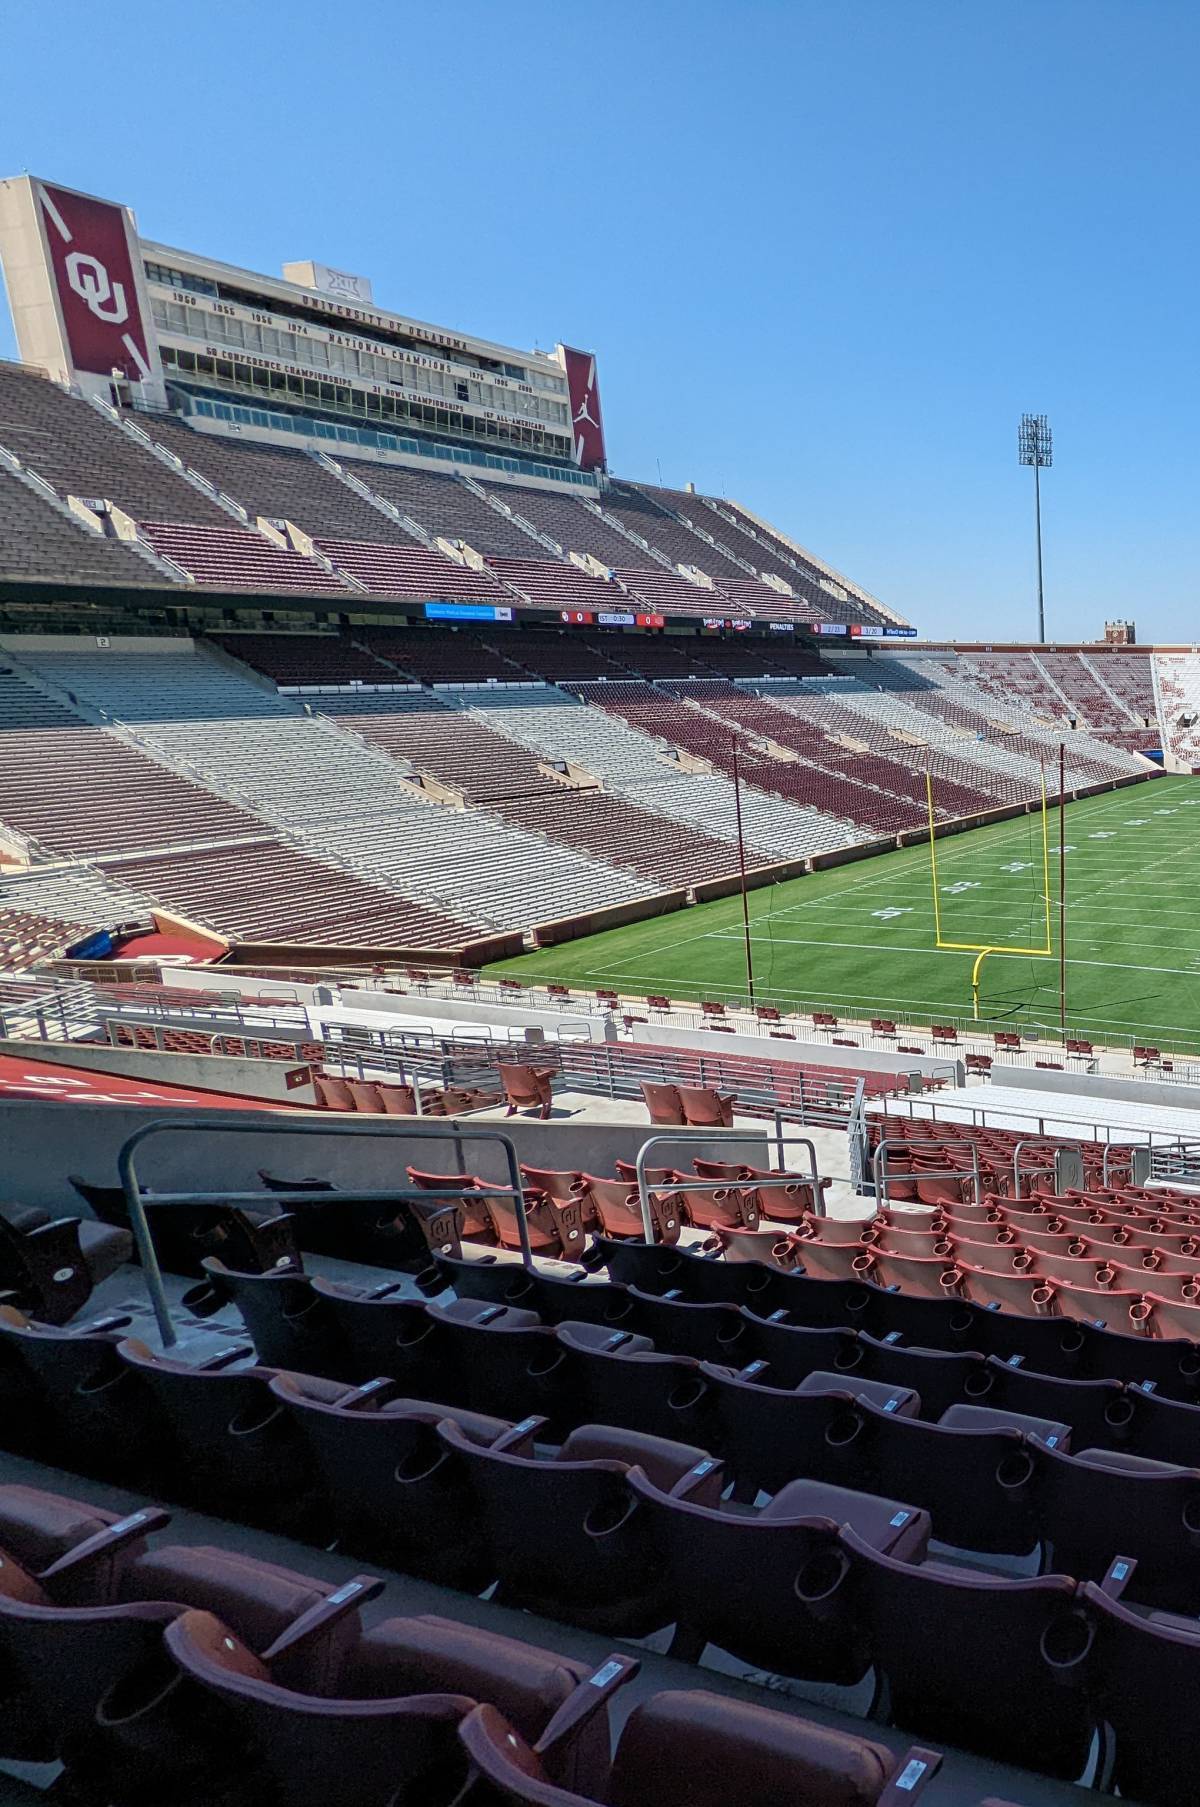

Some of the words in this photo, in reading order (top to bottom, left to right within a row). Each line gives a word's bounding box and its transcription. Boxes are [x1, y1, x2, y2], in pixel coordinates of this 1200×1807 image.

[65, 252, 128, 324] OU
[173, 292, 197, 306] 1950
[213, 303, 236, 316] 1955
[252, 313, 273, 325] 1956
[288, 322, 308, 335] 1974
[328, 333, 386, 356] NATIONAL
[392, 350, 452, 373] CHAMPIONS
[518, 384, 533, 394] 2000
[302, 295, 382, 327] UNIVERSITY
[389, 321, 402, 331] OF
[409, 326, 467, 350] OKLAHOMA
[222, 350, 281, 371] CONFERENCE
[284, 365, 352, 387] CHAMPIONSHIPS
[385, 388, 405, 400] BOWL
[408, 393, 464, 413] CHAMPIONSHIPS
[497, 415, 546, 431] ALL-AMERICANS
[577, 612, 583, 622] 0
[645, 616, 651, 624] 0
[770, 622, 794, 631] PENALTIES
